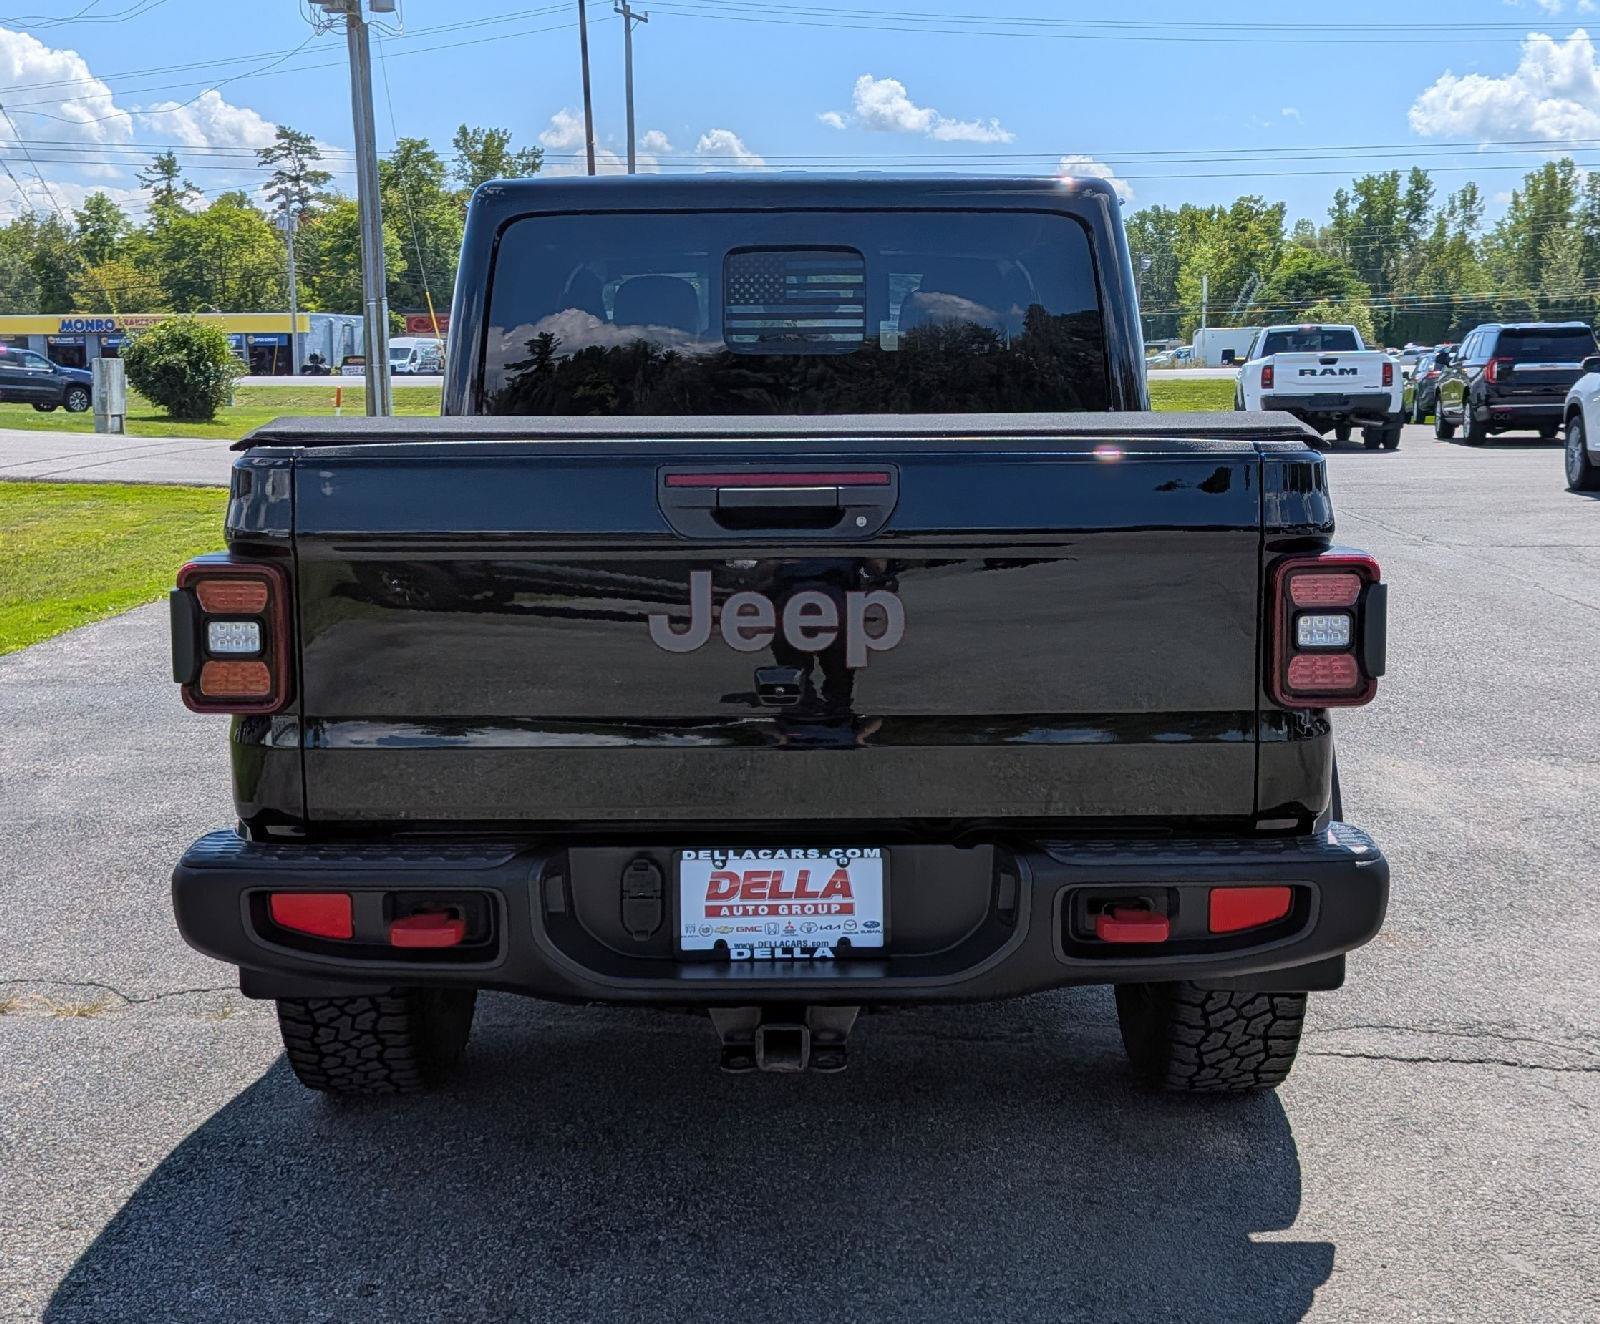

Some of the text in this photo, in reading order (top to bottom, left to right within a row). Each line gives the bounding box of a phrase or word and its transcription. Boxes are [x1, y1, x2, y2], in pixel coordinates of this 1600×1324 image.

[60, 319, 116, 332] MONRO
[1298, 368, 1358, 376] RAM
[648, 570, 906, 669] Jeep
[682, 848, 881, 860] DELLACARS.COM
[705, 868, 854, 902] DELLA
[720, 903, 841, 917] AUTO GROUP
[736, 925, 763, 933] GMC
[730, 948, 836, 961] DELLA
